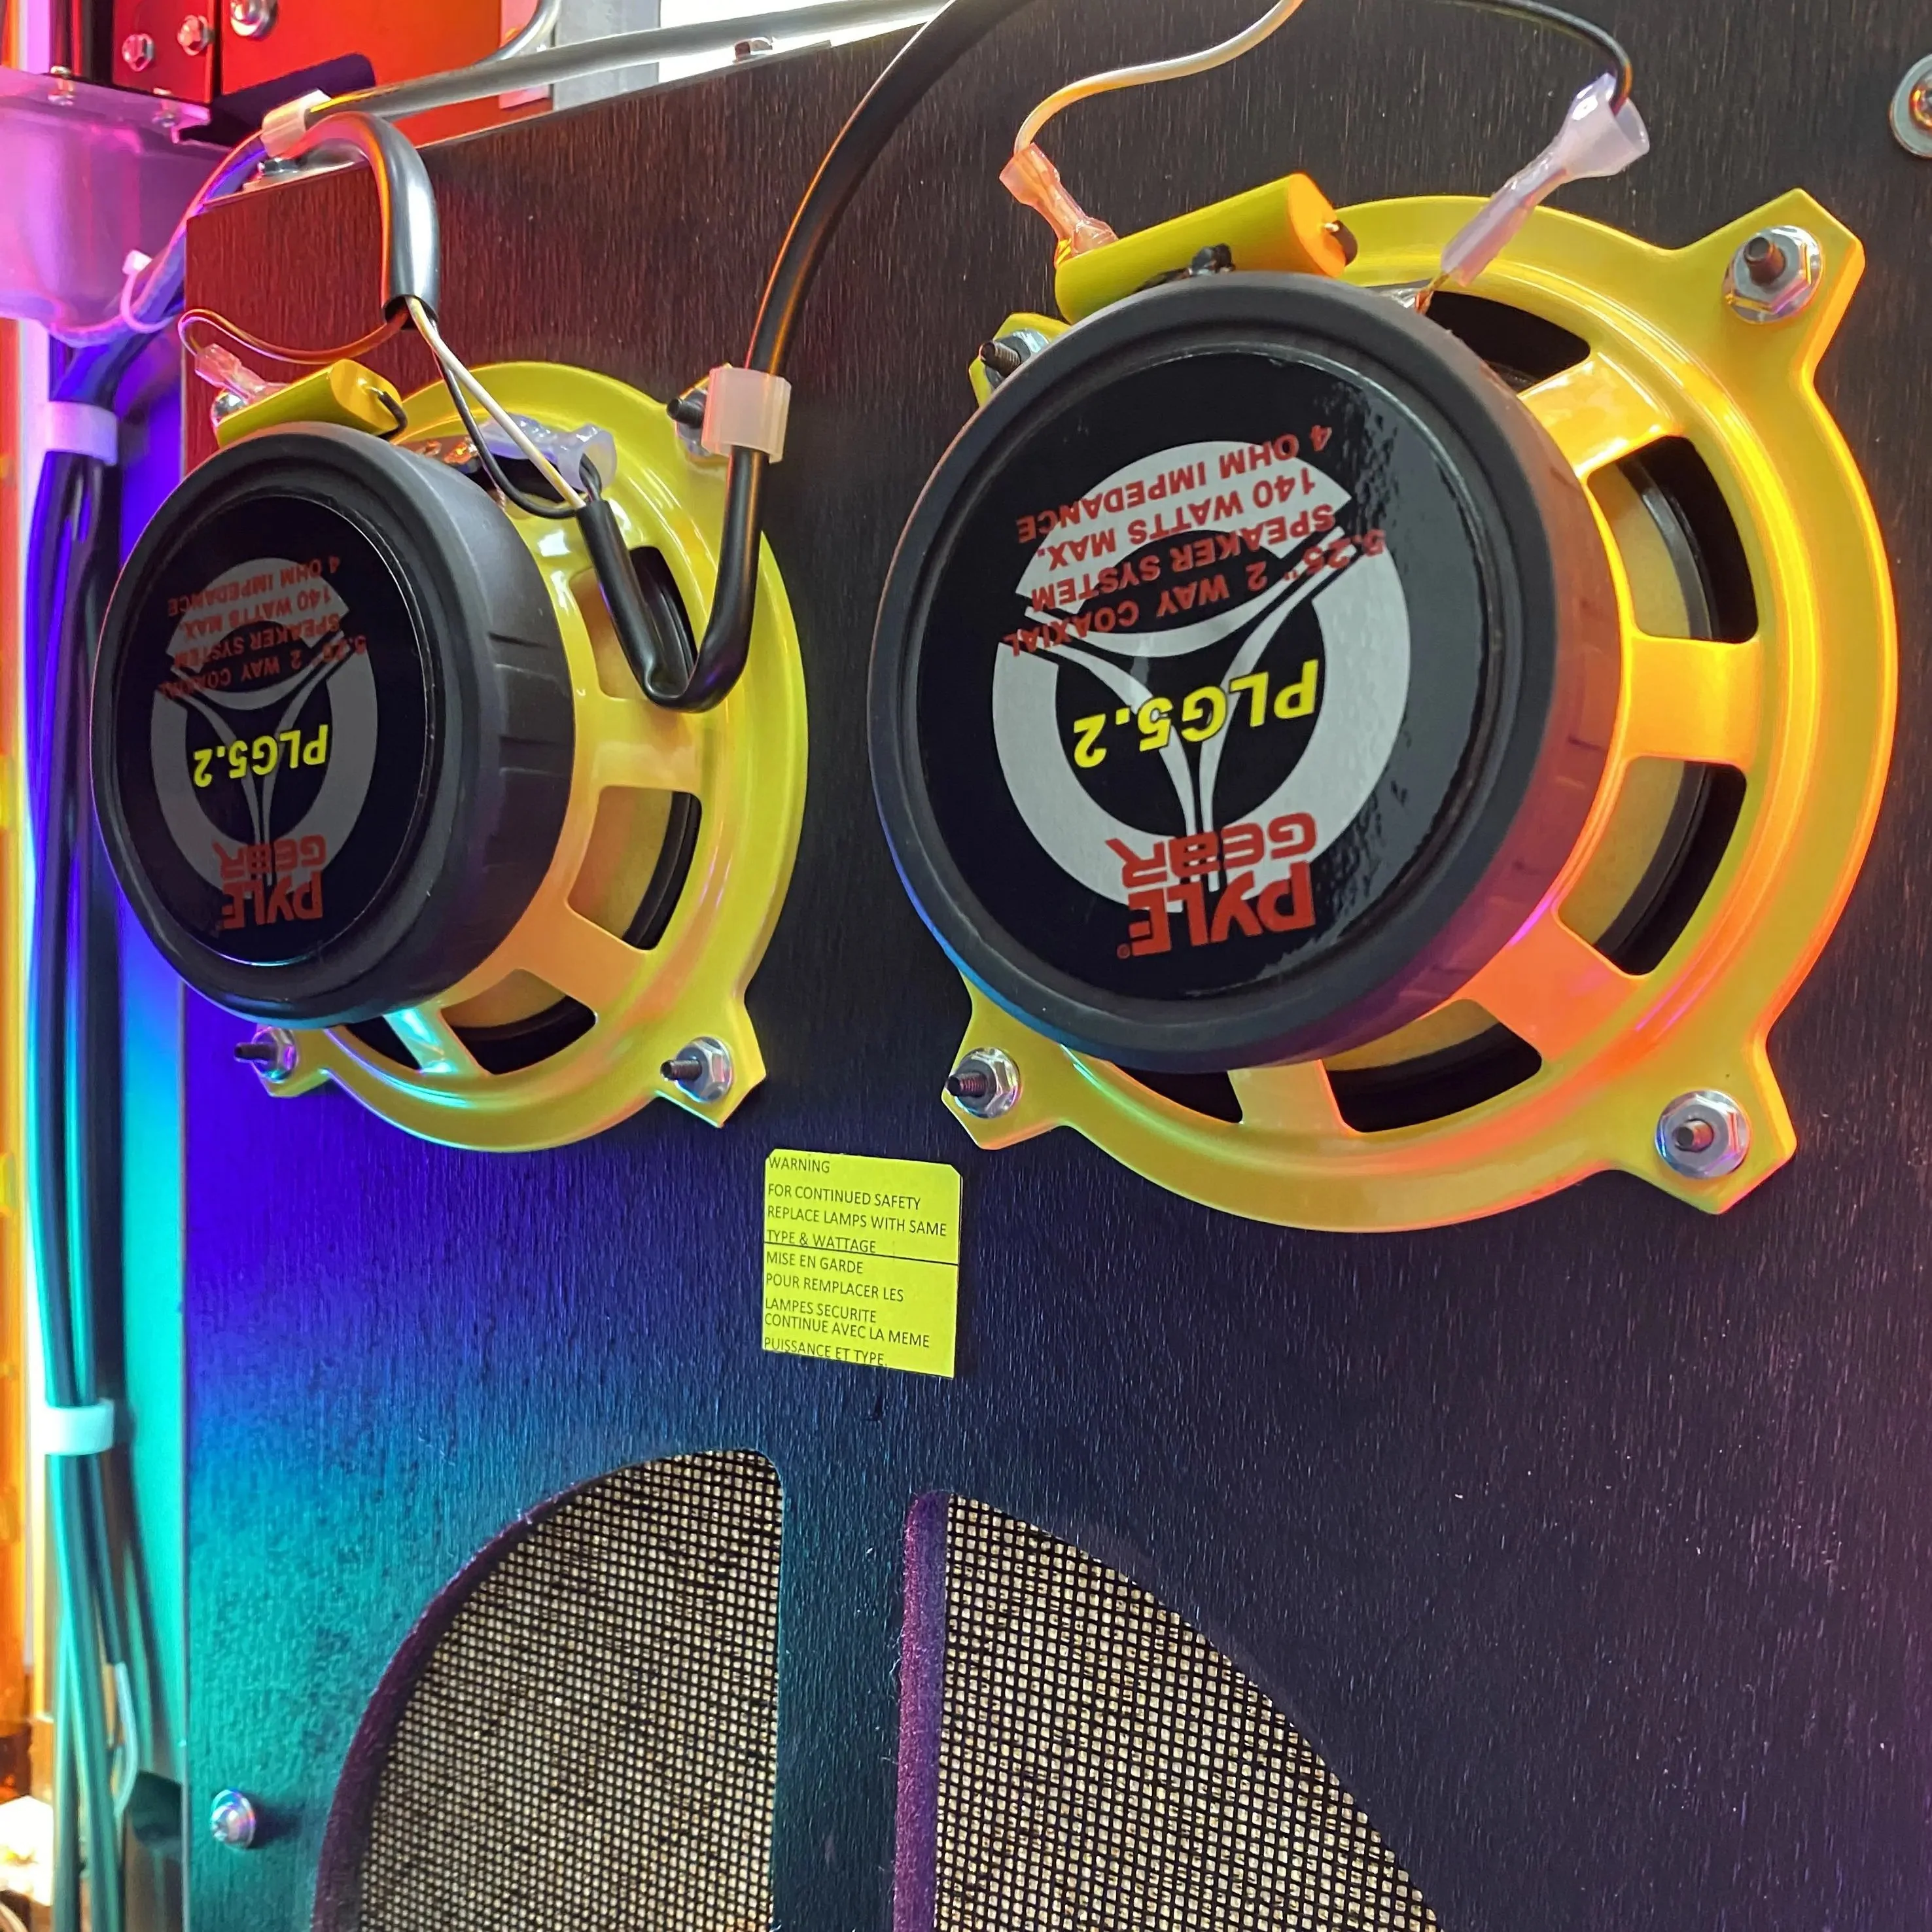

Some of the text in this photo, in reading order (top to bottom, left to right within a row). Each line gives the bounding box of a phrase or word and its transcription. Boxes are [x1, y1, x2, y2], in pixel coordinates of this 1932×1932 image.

[1017, 425, 1332, 544] 4 OHM IMPEDANCE
[1037, 467, 1315, 571] 140 WATTS MAX.
[1032, 504, 1336, 612] SPEAKER SYSTEM
[167, 555, 340, 617] 4 OHM IMPEDANCE
[1247, 561, 1267, 591] 2
[297, 586, 331, 610] 140
[1157, 574, 1230, 618] WAY
[250, 612, 340, 651] SPEAKER
[1003, 601, 1140, 657] COAXIAL
[240, 656, 279, 680] WAY
[290, 650, 301, 669] 2
[1073, 659, 1319, 769] PLG5.2
[193, 724, 328, 788] PLG5.2
[211, 834, 326, 880] GEAR
[1105, 812, 1318, 888] GEAR
[221, 871, 323, 930] PYLE
[769, 1156, 830, 1174] WARNING
[768, 1183, 921, 1210] FOR CONTINUED SAFETY
[767, 1205, 947, 1237] REPLACE LAMPS WITH SAME
[767, 1229, 876, 1254] TYPE & WATTAGE
[766, 1251, 864, 1274] MISE EN GARDE
[766, 1273, 904, 1302] POUR REMPLACER LES
[765, 1297, 877, 1323] LAMPES SECURITE
[764, 1313, 930, 1348] CONTINUE AVEC LA MEME
[764, 1337, 831, 1358] PUISSANCE
[835, 1346, 851, 1361] ET
